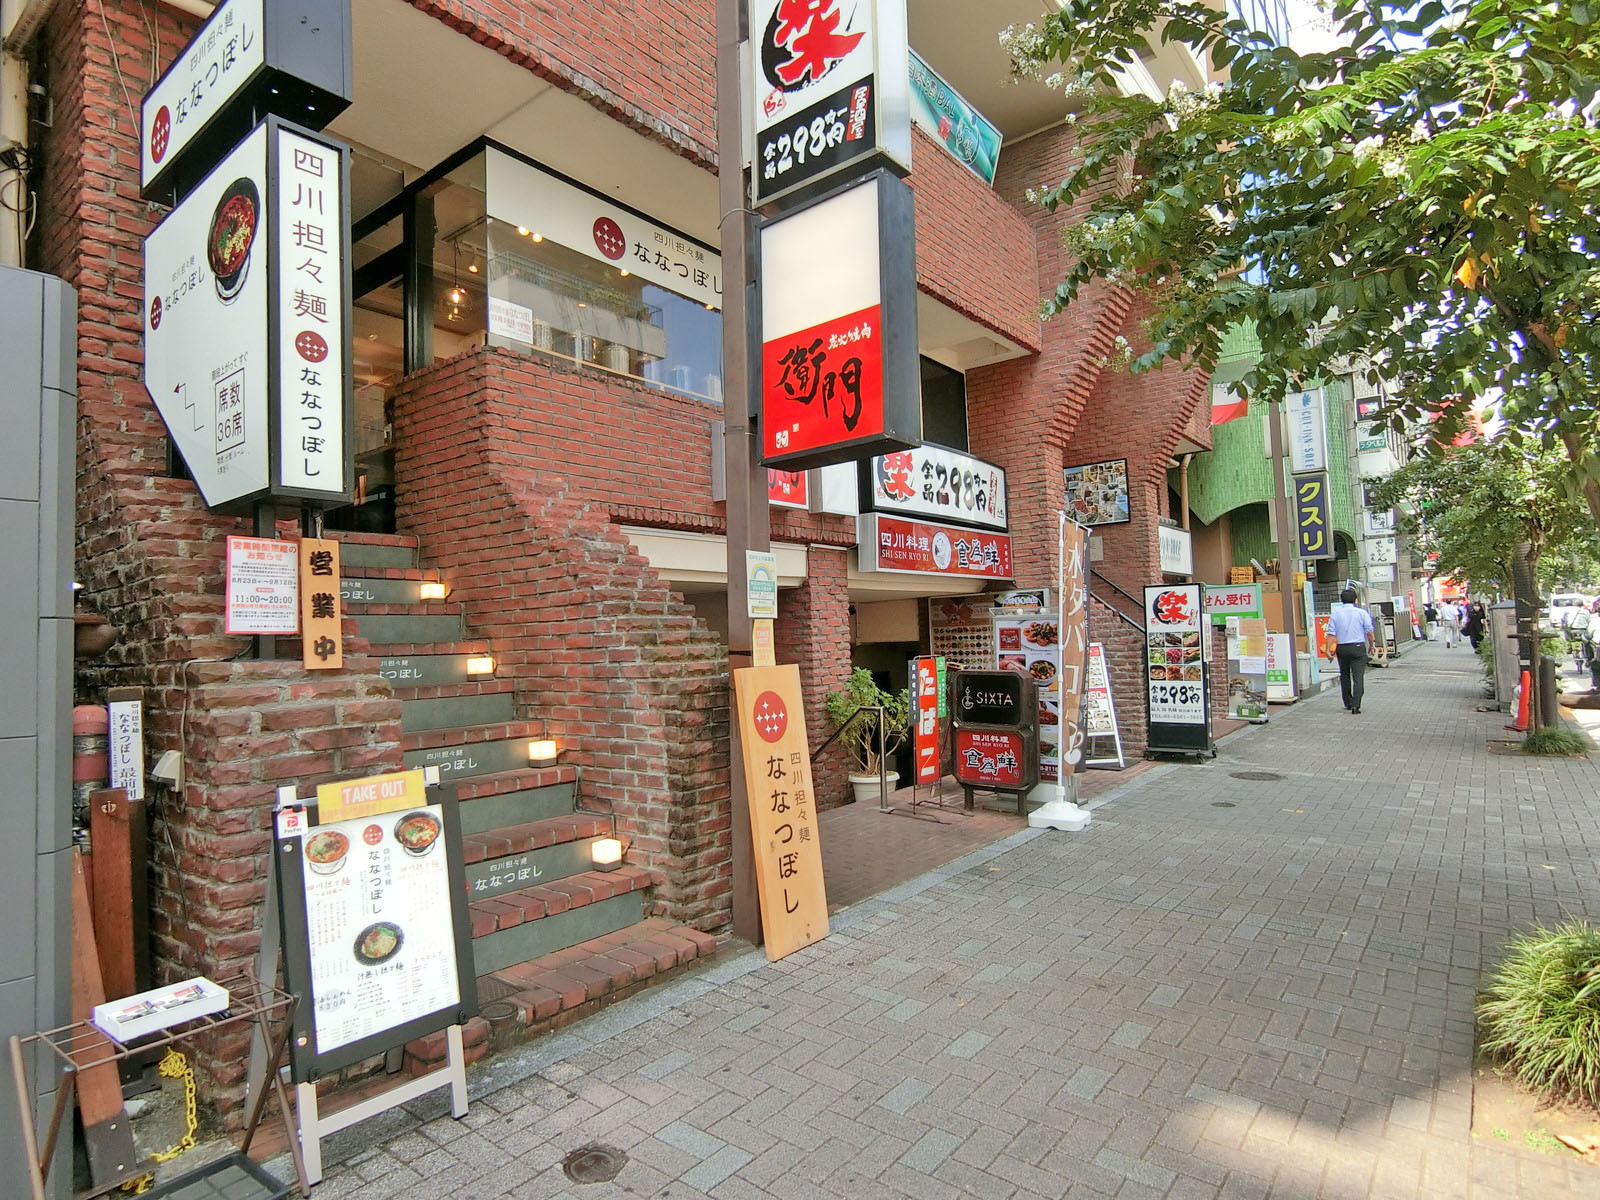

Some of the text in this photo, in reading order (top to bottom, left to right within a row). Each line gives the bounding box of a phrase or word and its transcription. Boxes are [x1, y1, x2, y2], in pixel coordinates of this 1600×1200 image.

[175, 23, 255, 125] ななつぼし
[849, 85, 868, 139] 居酒屋
[292, 148, 329, 324] 四川担々麺
[653, 231, 706, 264] 四川担々麺
[164, 265, 206, 312] ななつぼし
[634, 241, 722, 294] ななつぼし
[828, 322, 872, 350] 炭火焼肉
[219, 380, 241, 413] 席数
[217, 411, 243, 442] 36席
[300, 367, 326, 477] ななつぼし
[1299, 481, 1323, 551] クスリ
[881, 531, 930, 552] 四川料理
[881, 549, 930, 562] SHI SEN RYO RI
[309, 550, 337, 661] 営業中
[1064, 541, 1085, 695] 水タバコ
[1158, 590, 1190, 623] 楽
[1205, 592, 1252, 606] せん受付
[919, 667, 936, 777] たばこ
[976, 691, 1014, 706] SIXTA
[119, 713, 132, 764] ななつぼし
[972, 734, 1010, 744] 四川料理
[342, 779, 405, 804] TAKE OUT
[790, 752, 811, 843] 四川担々麺
[767, 755, 800, 915] ななつぼし
[368, 850, 383, 915] ななつぼし
[474, 865, 543, 891] ななつぼし
[489, 856, 528, 872] 四川担々麺
